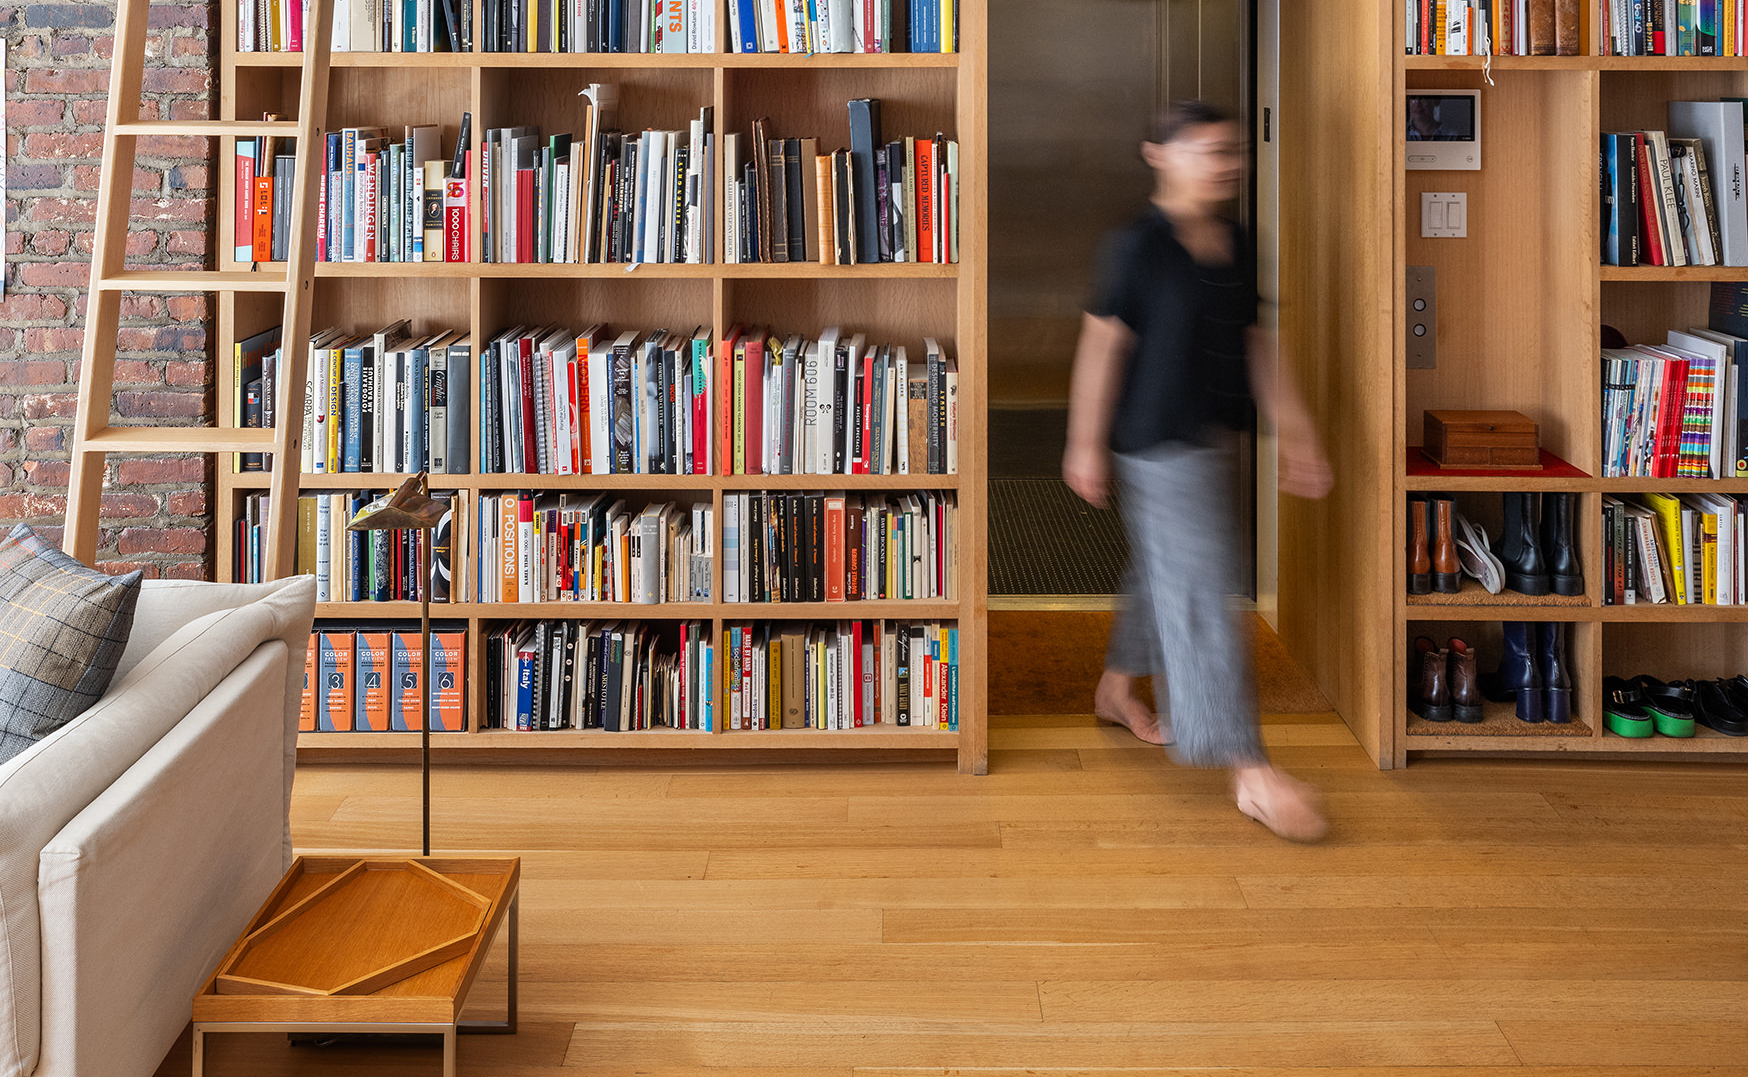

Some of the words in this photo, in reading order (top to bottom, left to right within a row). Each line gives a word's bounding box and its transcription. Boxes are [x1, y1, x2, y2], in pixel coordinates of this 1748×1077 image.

[345, 132, 353, 174] BAUHAUS
[1688, 152, 1697, 176] MARINO
[920, 155, 929, 193] CAPTURED
[1660, 159, 1670, 184] PAUL
[1664, 186, 1675, 209] KLEE
[1692, 178, 1700, 198] MARINI
[367, 163, 375, 240] WENDINGEN
[578, 354, 590, 413] MODERN
[806, 361, 817, 385] 606
[434, 371, 446, 402] Graphic
[368, 401, 373, 413] AM
[805, 389, 817, 426] ROOM
[931, 406, 939, 447] MODERNITY
[1650, 539, 1658, 567] AMERICANAH
[331, 674, 340, 689] 3
[367, 674, 377, 688] 4
[405, 675, 413, 689] 5
[441, 674, 451, 689] 6
[520, 669, 531, 689] Italy
